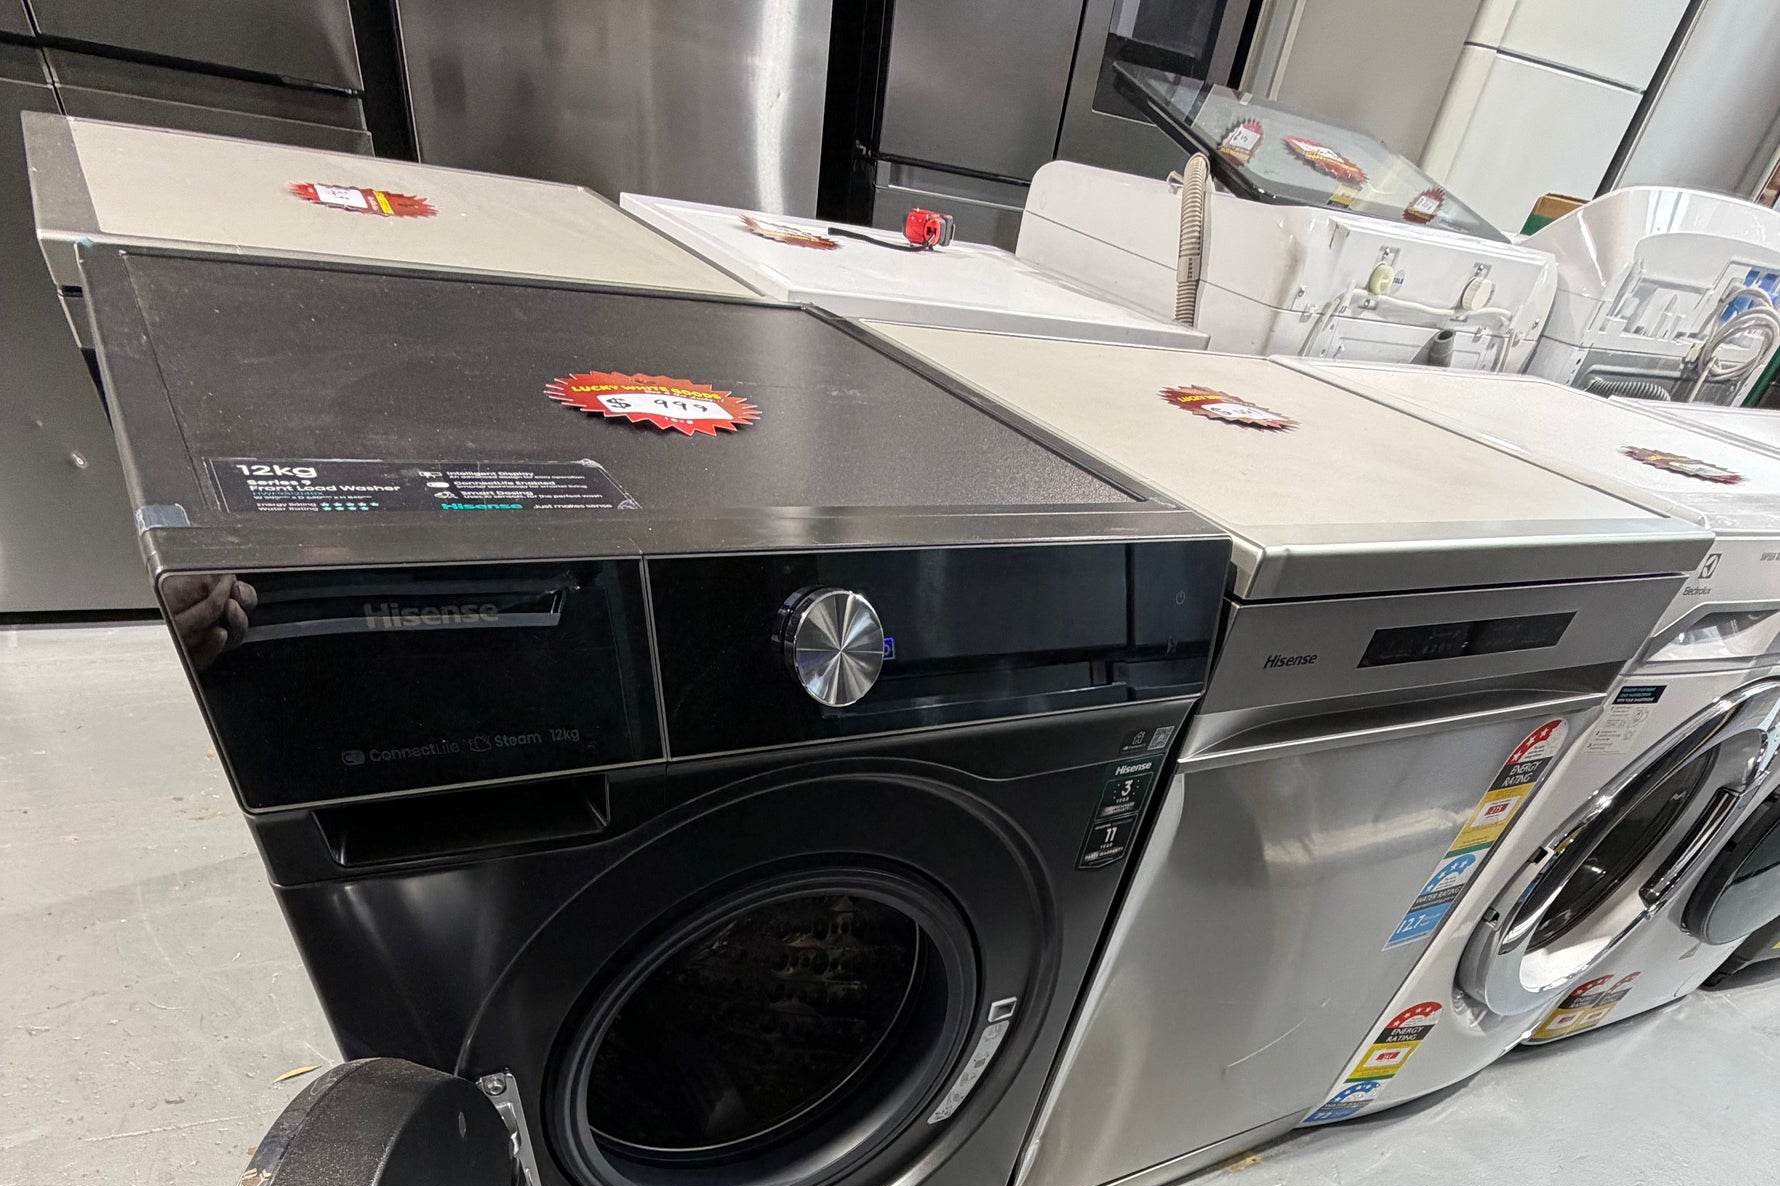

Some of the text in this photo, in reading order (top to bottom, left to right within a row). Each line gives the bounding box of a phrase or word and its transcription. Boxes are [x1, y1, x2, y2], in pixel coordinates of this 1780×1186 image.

[571, 384, 618, 392] LUCKY
[670, 387, 722, 400] GOODS
[606, 397, 632, 409] $
[236, 464, 318, 479] 12kg
[441, 502, 523, 511] Hisense
[363, 602, 499, 629] Hisense
[1262, 652, 1318, 669] Hisense
[494, 728, 581, 748] Steam 12kg
[369, 741, 460, 763] ConnectLife
[1115, 761, 1153, 776] Hisense
[1509, 760, 1543, 776] ENERGY
[1121, 779, 1134, 796] 3
[1501, 773, 1533, 788] RATING
[1104, 826, 1118, 843] 11
[1385, 1034, 1418, 1043] RATING
[1390, 1026, 1424, 1036] ENERGY
